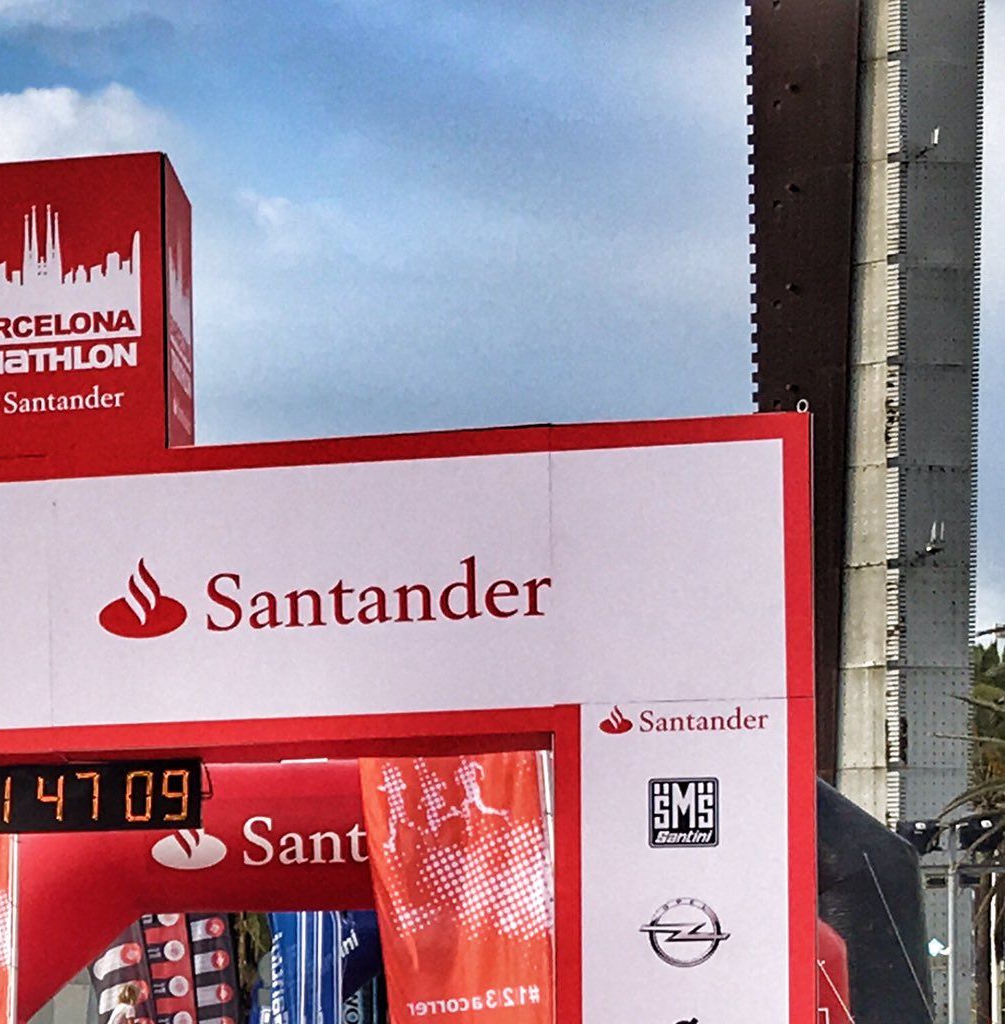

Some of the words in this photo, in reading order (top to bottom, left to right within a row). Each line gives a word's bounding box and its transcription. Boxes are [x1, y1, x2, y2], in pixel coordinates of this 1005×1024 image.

[3, 385, 125, 414] Santander
[206, 555, 552, 631] Santander
[639, 706, 768, 732] Santander
[654, 783, 713, 829] SMS
[655, 830, 712, 843] Santini
